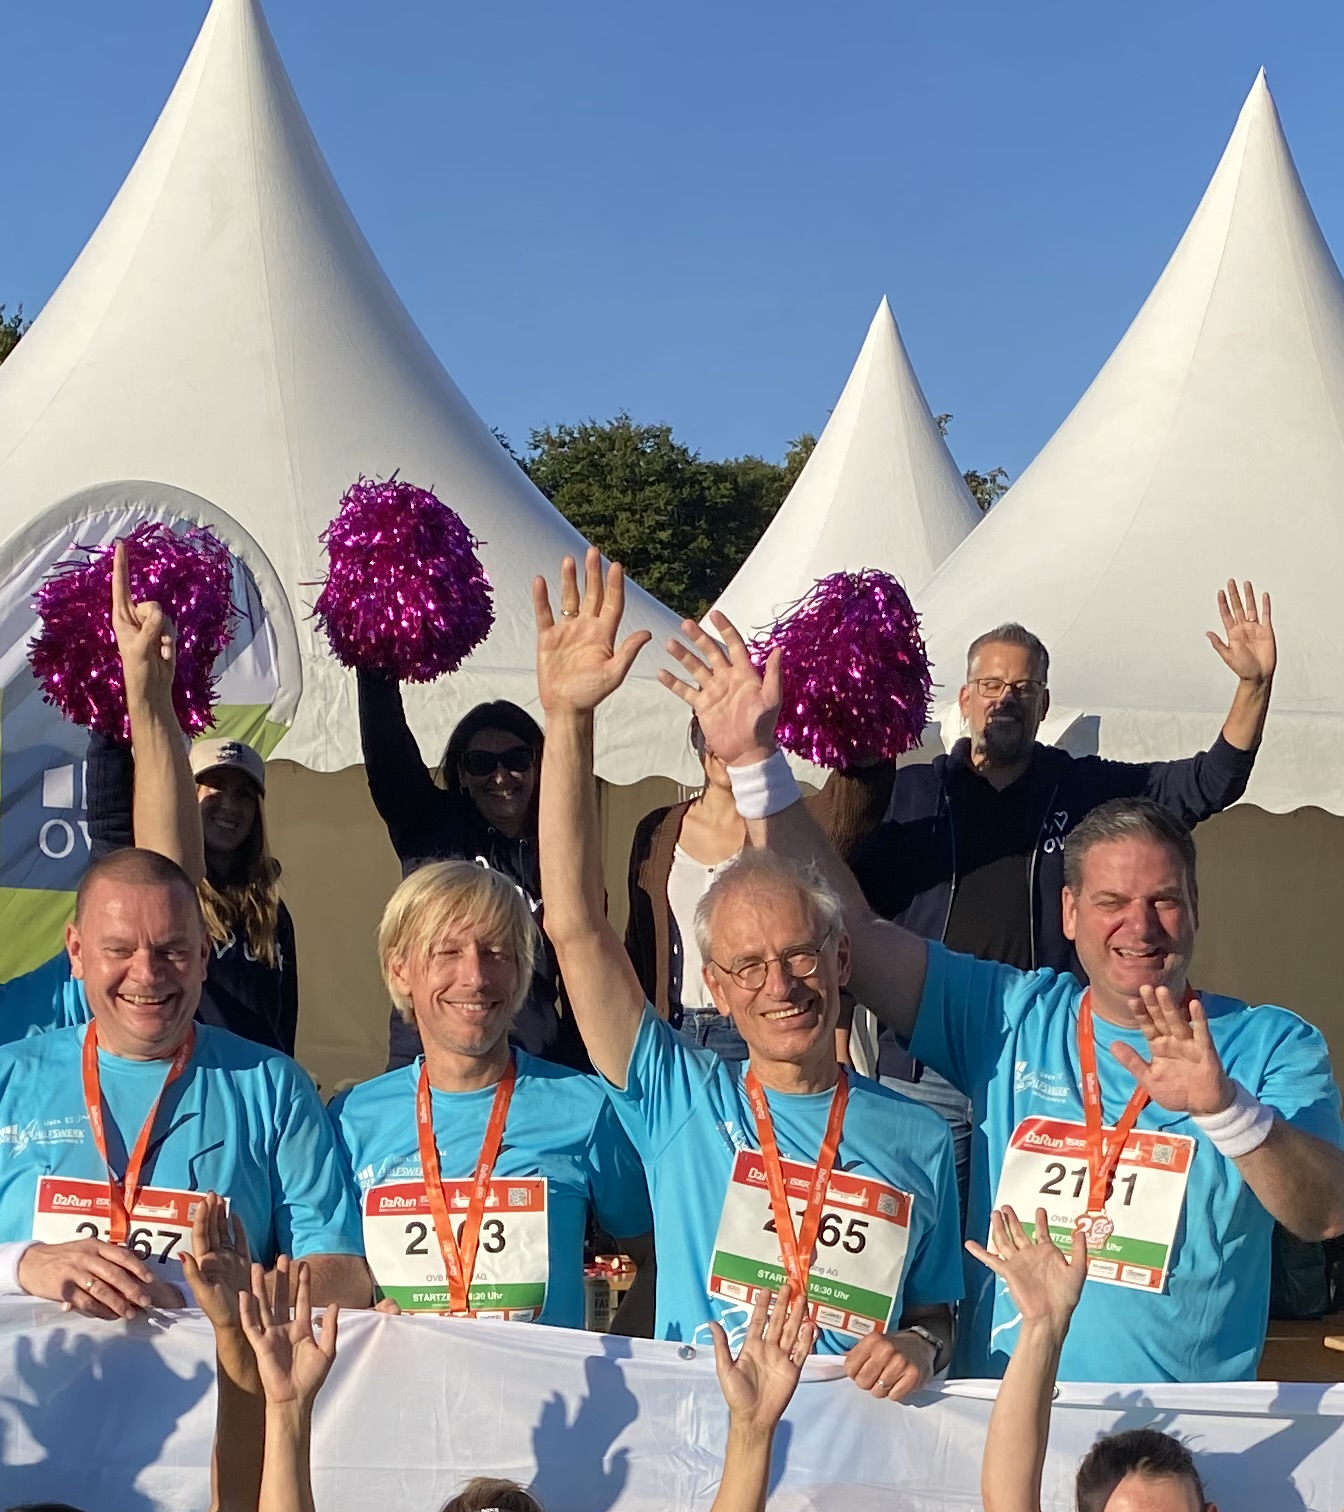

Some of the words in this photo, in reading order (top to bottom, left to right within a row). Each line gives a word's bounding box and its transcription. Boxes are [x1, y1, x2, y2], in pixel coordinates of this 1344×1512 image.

[1039, 1162, 1138, 1206] 211
[75, 1222, 182, 1264] 267
[405, 1219, 506, 1255] 23
[763, 1203, 869, 1254] 65
[1106, 1243, 1123, 1253] Uhr
[475, 1273, 487, 1281] AG
[757, 1269, 788, 1284] START
[809, 1282, 833, 1296] 16:30
[833, 1289, 850, 1301] Uhr
[826, 1266, 838, 1277] AG
[413, 1292, 451, 1303] STARTZE
[487, 1291, 504, 1300] Uhr
